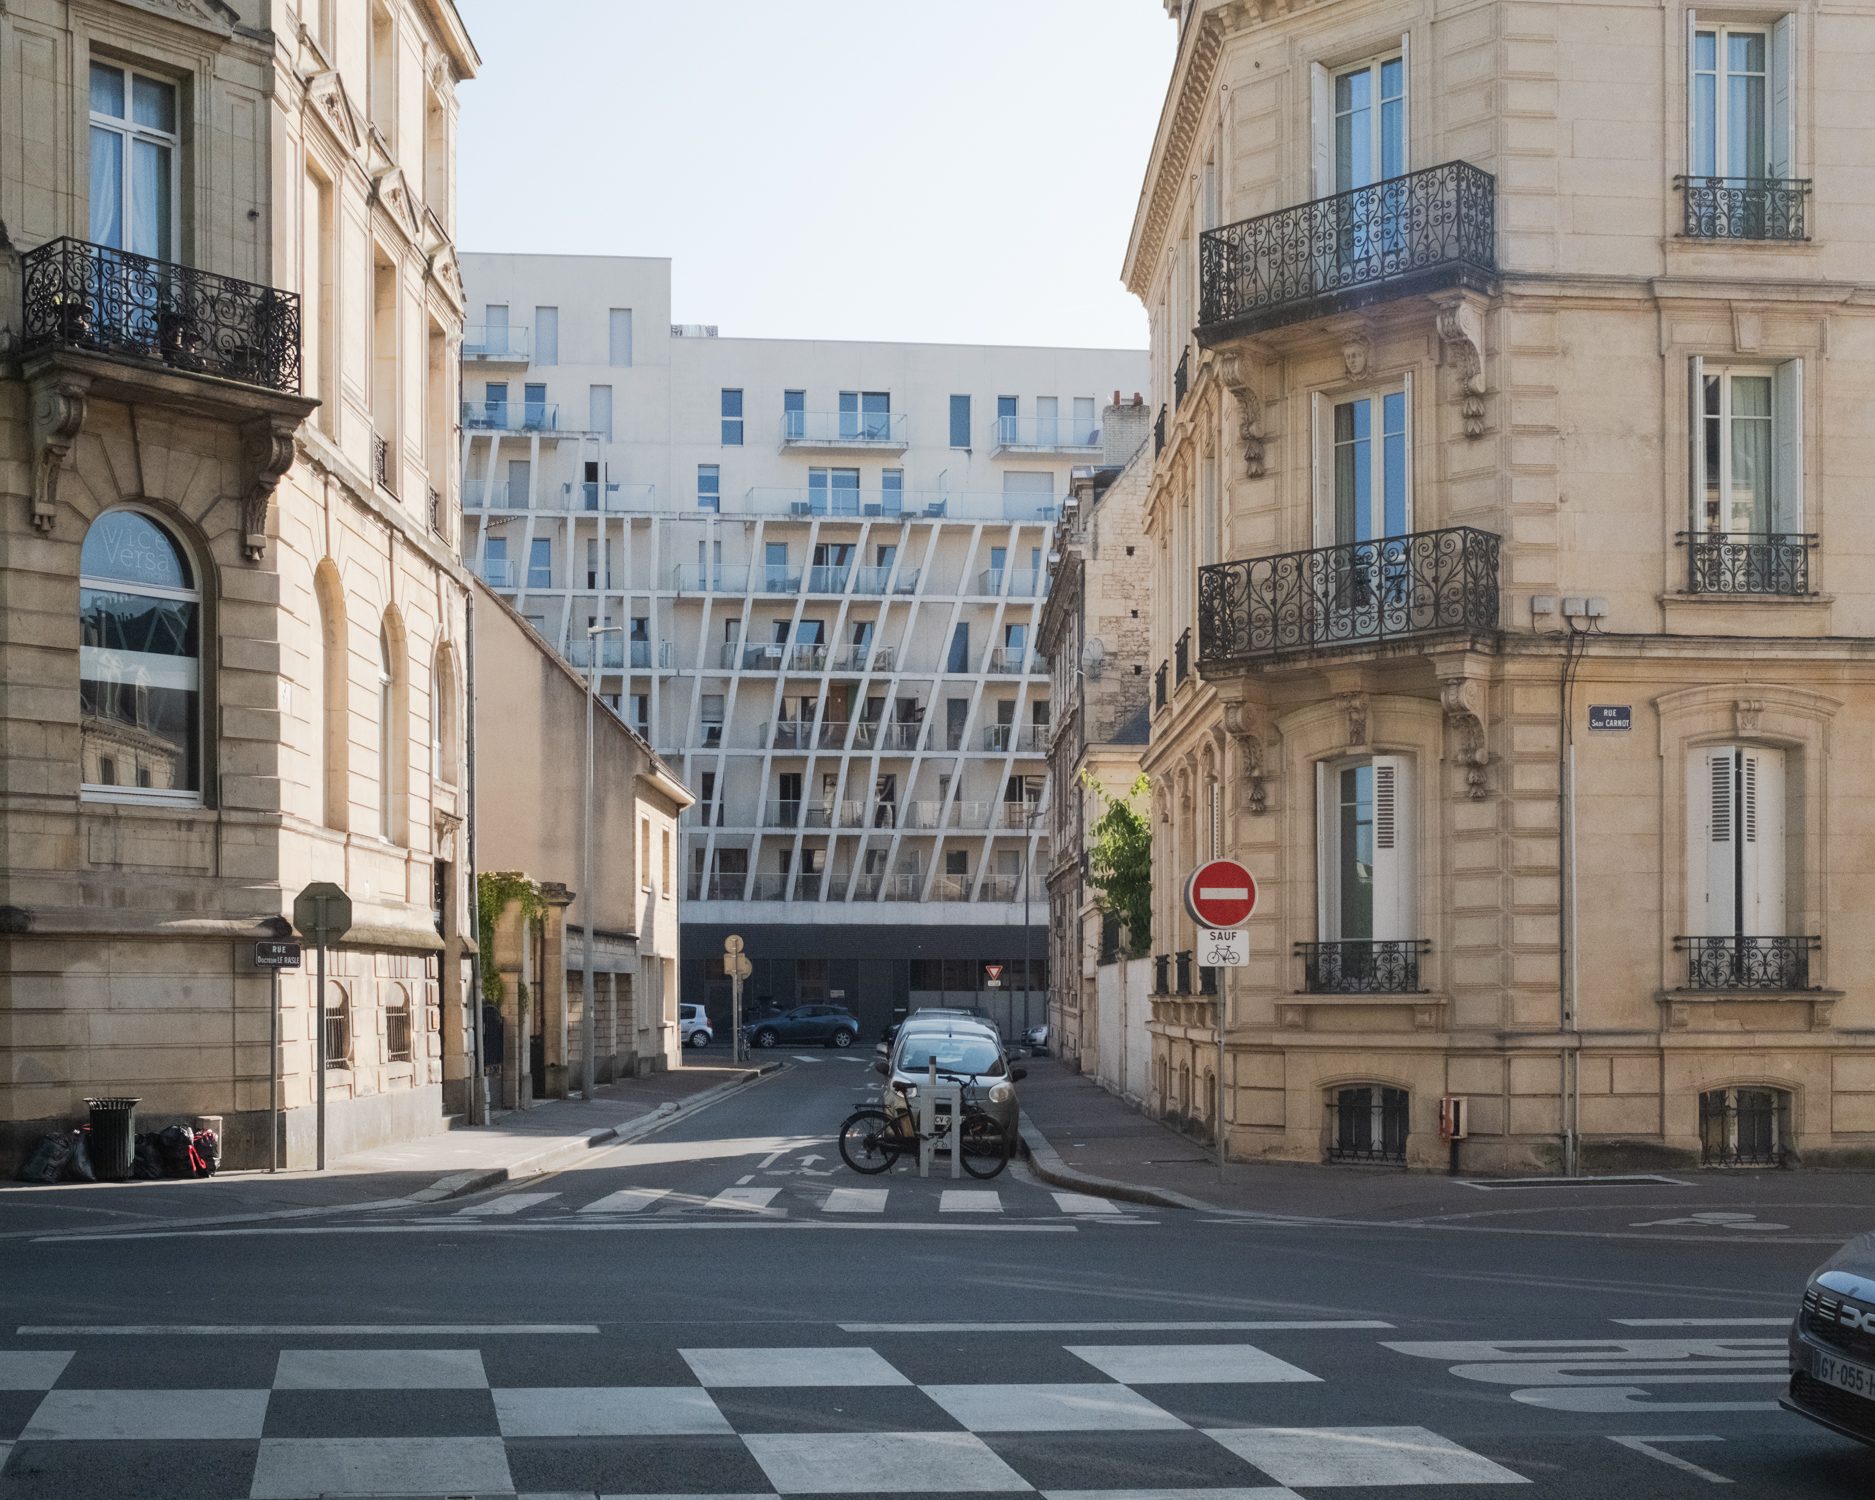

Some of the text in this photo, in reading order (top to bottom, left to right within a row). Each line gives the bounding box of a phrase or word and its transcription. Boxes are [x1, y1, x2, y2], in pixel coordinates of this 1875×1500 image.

[1603, 709, 1617, 717] RUE
[1605, 719, 1630, 727] CARNOT
[1209, 931, 1238, 941] SAUF
[272, 945, 287, 953] RUE
